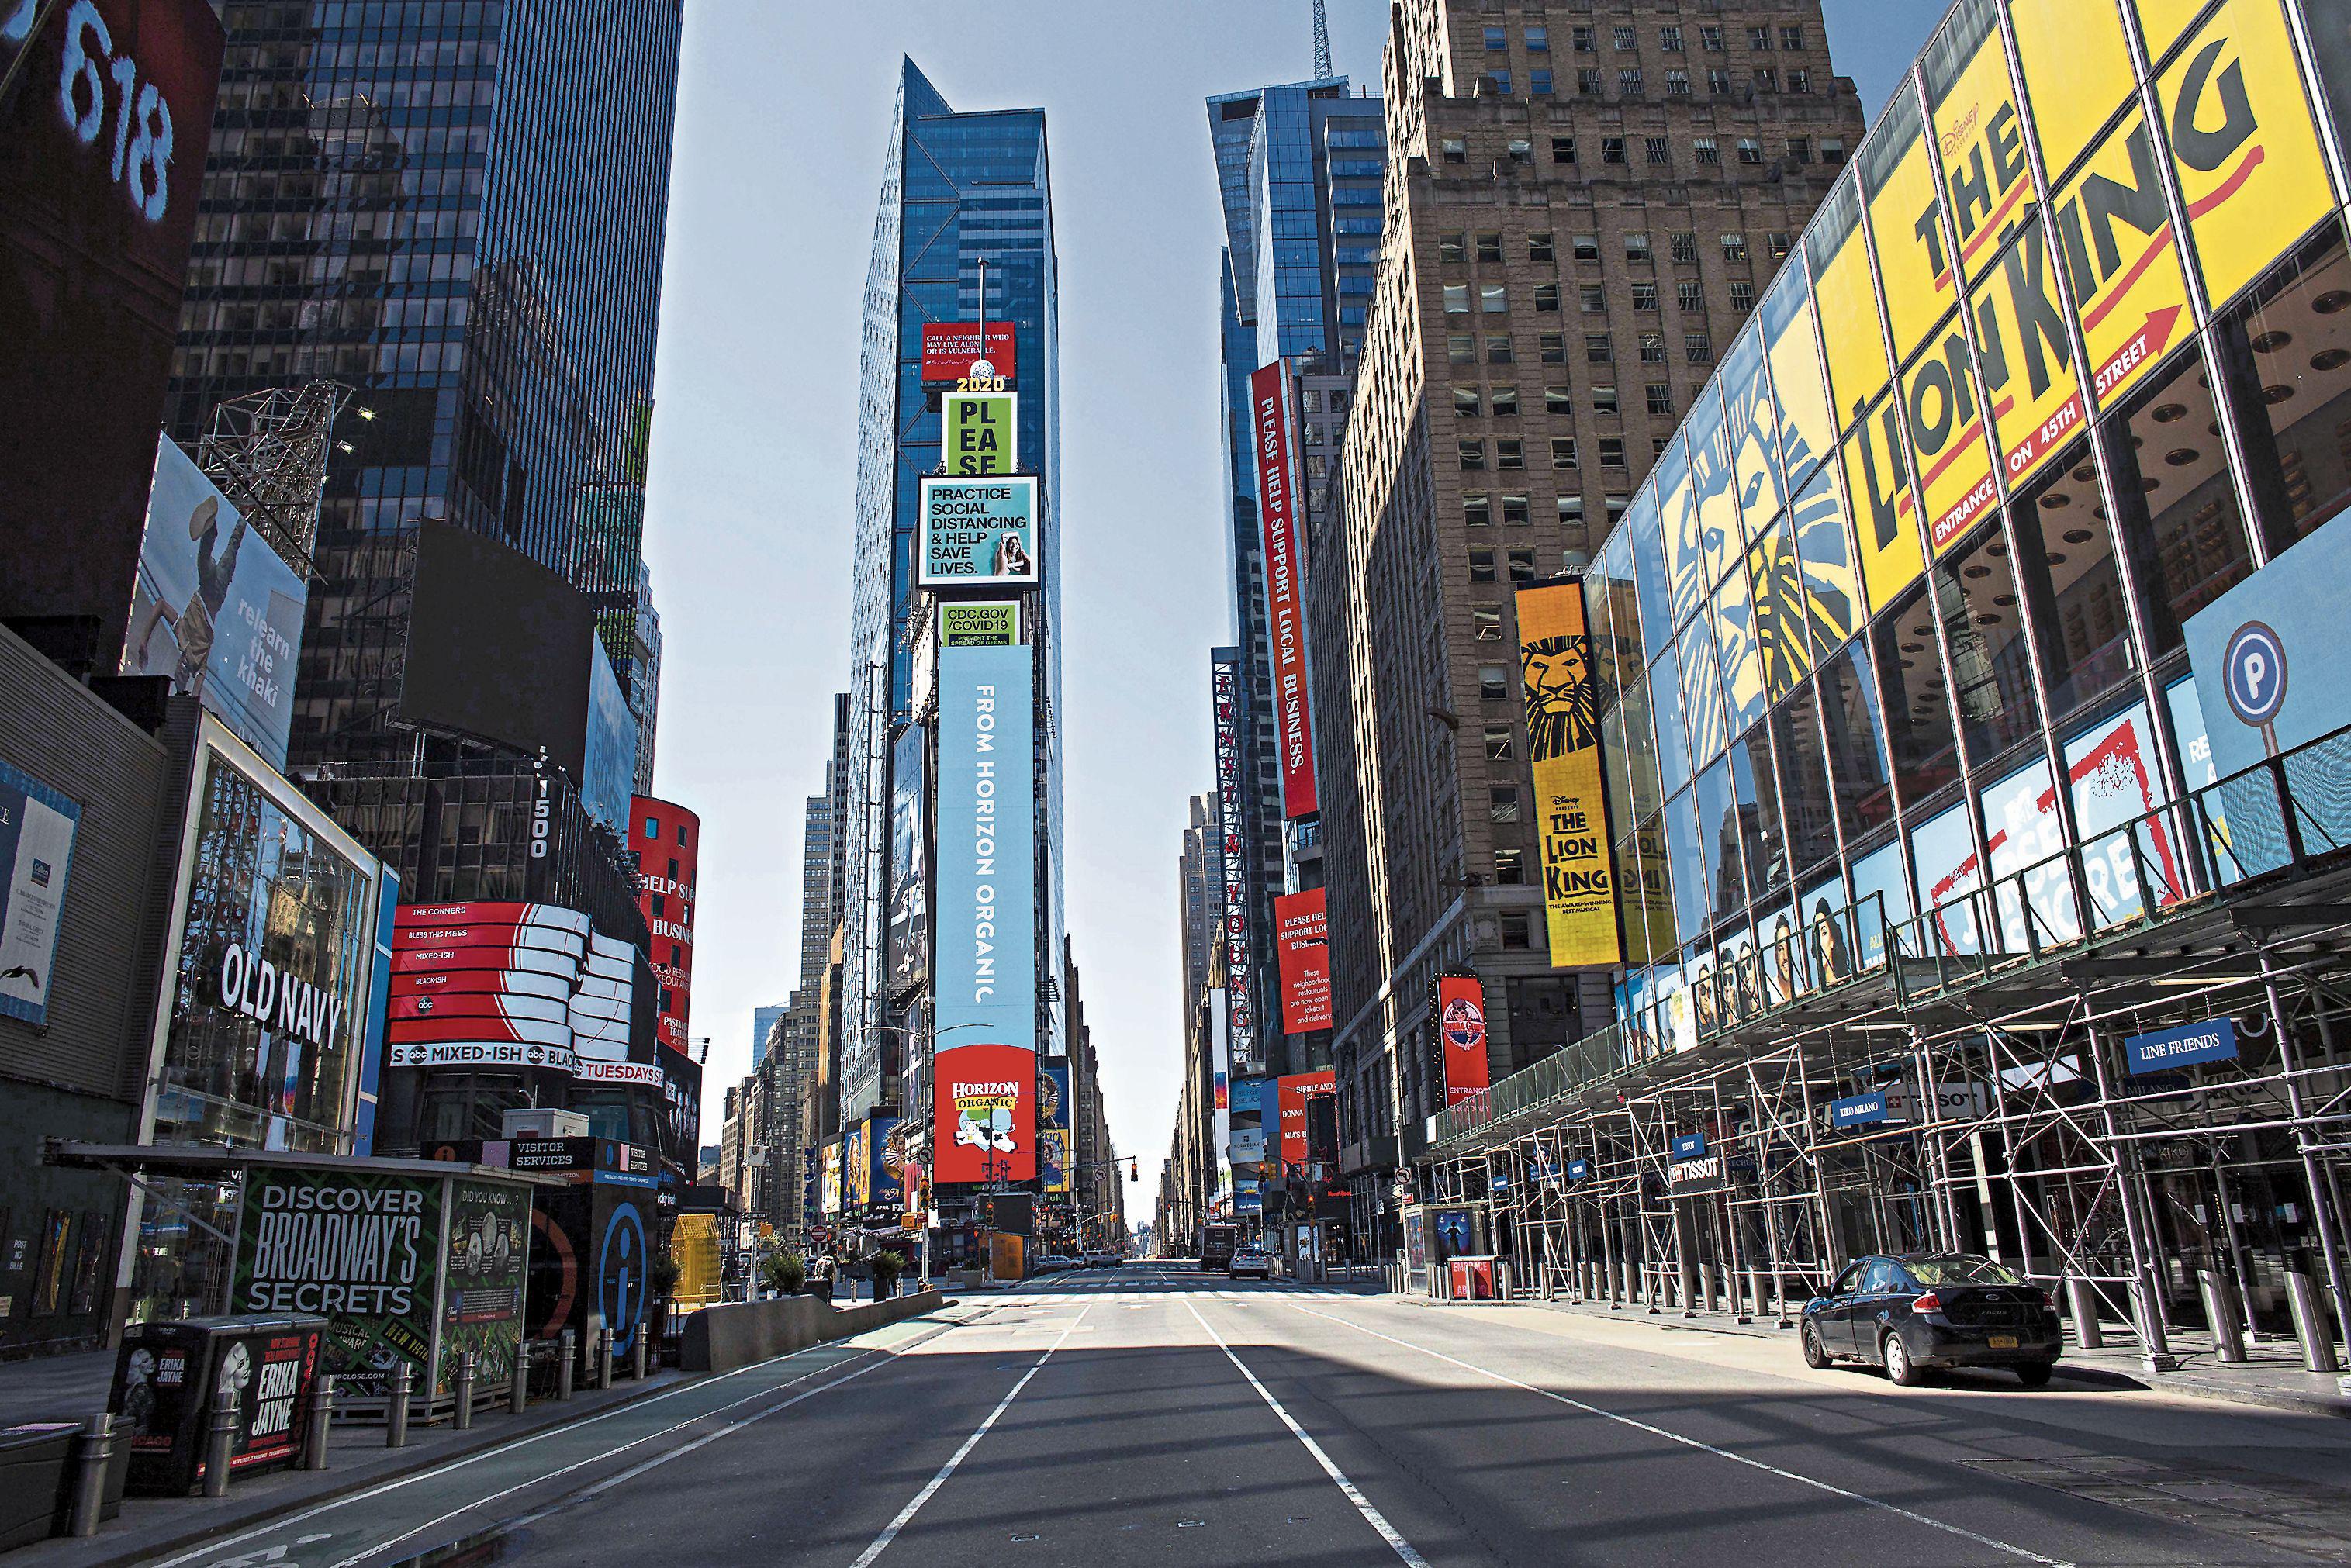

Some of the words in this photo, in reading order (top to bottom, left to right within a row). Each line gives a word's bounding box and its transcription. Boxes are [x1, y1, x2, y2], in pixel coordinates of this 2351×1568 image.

[60, 0, 174, 221] 618
[1939, 102, 1978, 156] Disney
[1915, 101, 2027, 281] THE
[1851, 285, 2010, 553] LION
[2000, 39, 2259, 402] KING
[956, 378, 1004, 392] 2020
[1261, 396, 1279, 465] PLEASE
[1934, 480, 1994, 541] ENTRANCE
[2010, 443, 2034, 474] ON
[2040, 402, 2077, 446] 45TH
[2095, 334, 2148, 395] STREET
[932, 488, 1011, 500] PRACTICE
[1267, 466, 1282, 513] HELP
[931, 503, 990, 515] SOCIAL
[932, 516, 1026, 530] DISTANCING
[931, 533, 942, 544] &
[946, 532, 987, 544] HELP
[931, 547, 971, 559] SAVE
[1271, 517, 1291, 603] SUPPORT
[931, 561, 978, 574] LIVES.
[948, 609, 1008, 620] CDC.GOV
[238, 598, 290, 660] relearn
[948, 620, 1008, 631] /COVID19
[1277, 608, 1295, 671] LOCAL
[250, 636, 273, 674] the
[237, 654, 279, 708] khaki
[976, 685, 995, 753] FROM
[1284, 674, 1304, 775] BUSINESS.
[1550, 796, 1580, 806] Disney
[530, 779, 550, 858] 1500
[976, 762, 995, 876] HORIZON
[1550, 812, 1587, 831] THE
[1546, 835, 1597, 864] LION
[1961, 780, 2098, 945] JRSEY
[1545, 866, 1609, 900] KING
[428, 907, 466, 915] CONNERS
[1561, 900, 1612, 909] AWARD-WINNING
[1284, 914, 1310, 927] PLEASE
[1281, 926, 1312, 940] SUPPORT
[976, 885, 995, 1003] ORGANIC
[1291, 938, 1325, 951] BUSI
[416, 952, 455, 960] MIXED-ISH
[416, 976, 447, 985] BLACK-ISH
[222, 943, 275, 1021] OLD
[278, 971, 342, 1049] NAVY
[1298, 987, 1328, 997] restaurants
[418, 1000, 433, 1009] abc
[1314, 996, 1329, 1005] open
[1304, 1005, 1325, 1014] takeout
[1297, 1016, 1308, 1024] and
[2140, 1044, 2167, 1060] LINE
[2169, 1033, 2220, 1055] FRIENDS
[409, 1048, 427, 1060] abc
[431, 1046, 523, 1062] MIXED-ISH
[527, 1050, 545, 1060] abc
[586, 1062, 654, 1083] TUESDAYS
[952, 1082, 1019, 1100] HORIZON
[1320, 1082, 1333, 1090] AND
[958, 1098, 1013, 1108] ORGANIC
[1839, 1107, 1854, 1117] KIKO
[1855, 1101, 1879, 1114] MILANO
[1282, 1109, 1304, 1118] DONNA
[1284, 1131, 1301, 1140] MIA'S
[517, 1142, 565, 1152] VISITOR
[631, 1148, 646, 1159] VISITOR
[516, 1155, 572, 1166] SERVICES
[1682, 1156, 1718, 1180] TISSOT
[263, 1186, 423, 1213] DISCOVER
[462, 1190, 473, 1203] DID
[475, 1192, 487, 1204] YOU
[892, 1203, 904, 1212] FX
[13, 1240, 28, 1249] POST
[253, 1211, 420, 1283] BROADWAY'S
[14, 1250, 22, 1259] NO
[9, 1262, 23, 1270] BILLS
[1457, 1284, 1487, 1296] ABRD
[247, 1282, 412, 1314] SECRETS
[330, 1321, 371, 1338] MUSICAL
[385, 1321, 411, 1345] NEW
[159, 1358, 185, 1371] ERIKA
[157, 1371, 184, 1383] JAYNE
[257, 1360, 299, 1400] ERIKA
[251, 1397, 295, 1436] JAYNE
